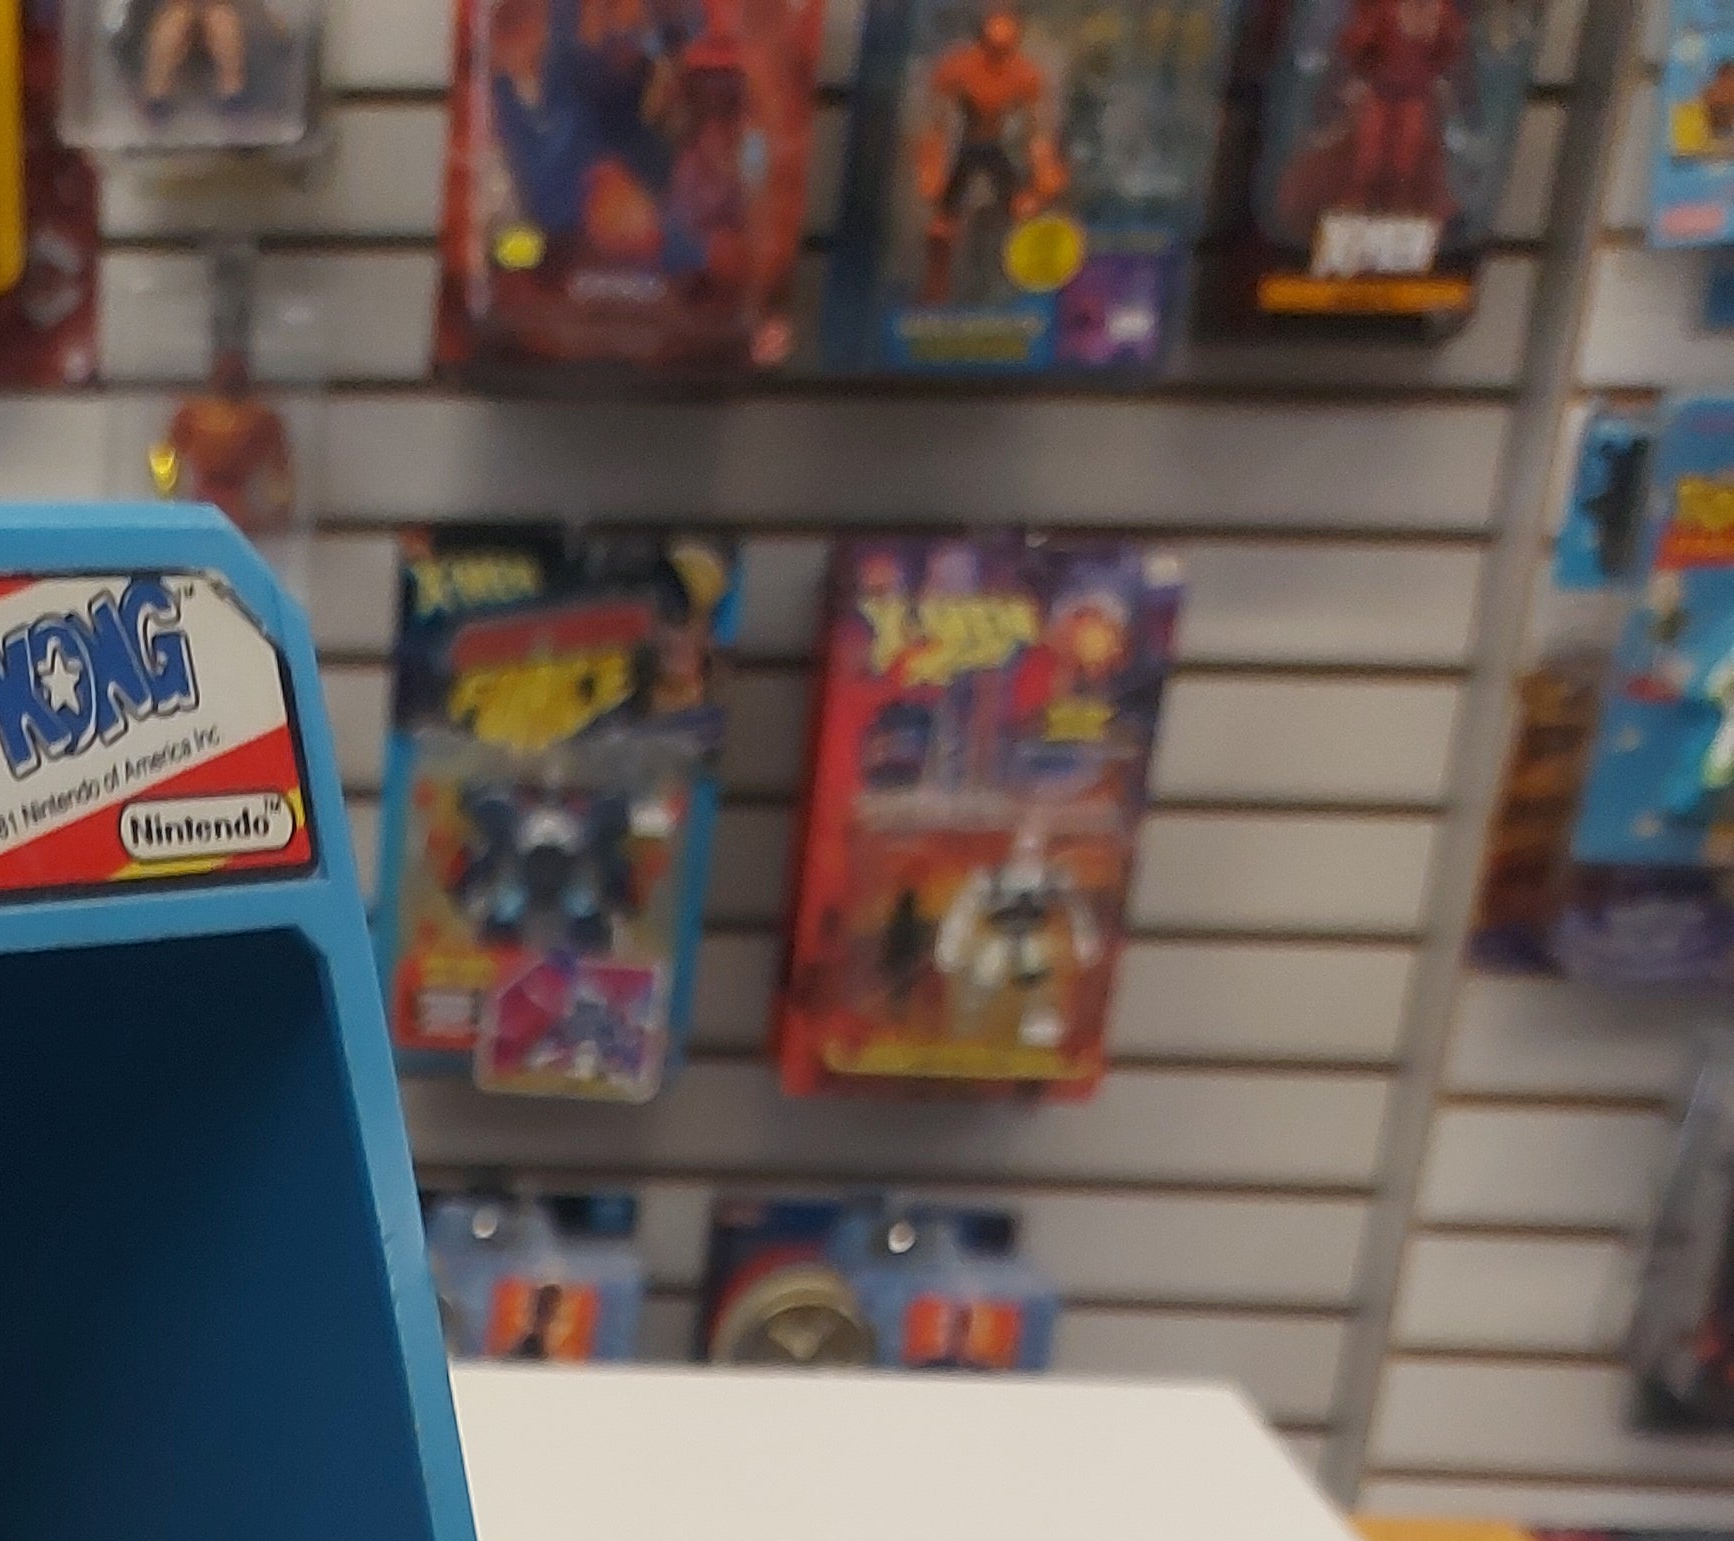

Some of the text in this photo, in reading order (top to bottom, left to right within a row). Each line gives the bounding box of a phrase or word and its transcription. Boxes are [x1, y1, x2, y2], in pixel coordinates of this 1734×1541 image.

[21, 780, 100, 829] Nintendo
[104, 764, 120, 790] of
[124, 736, 192, 783] America
